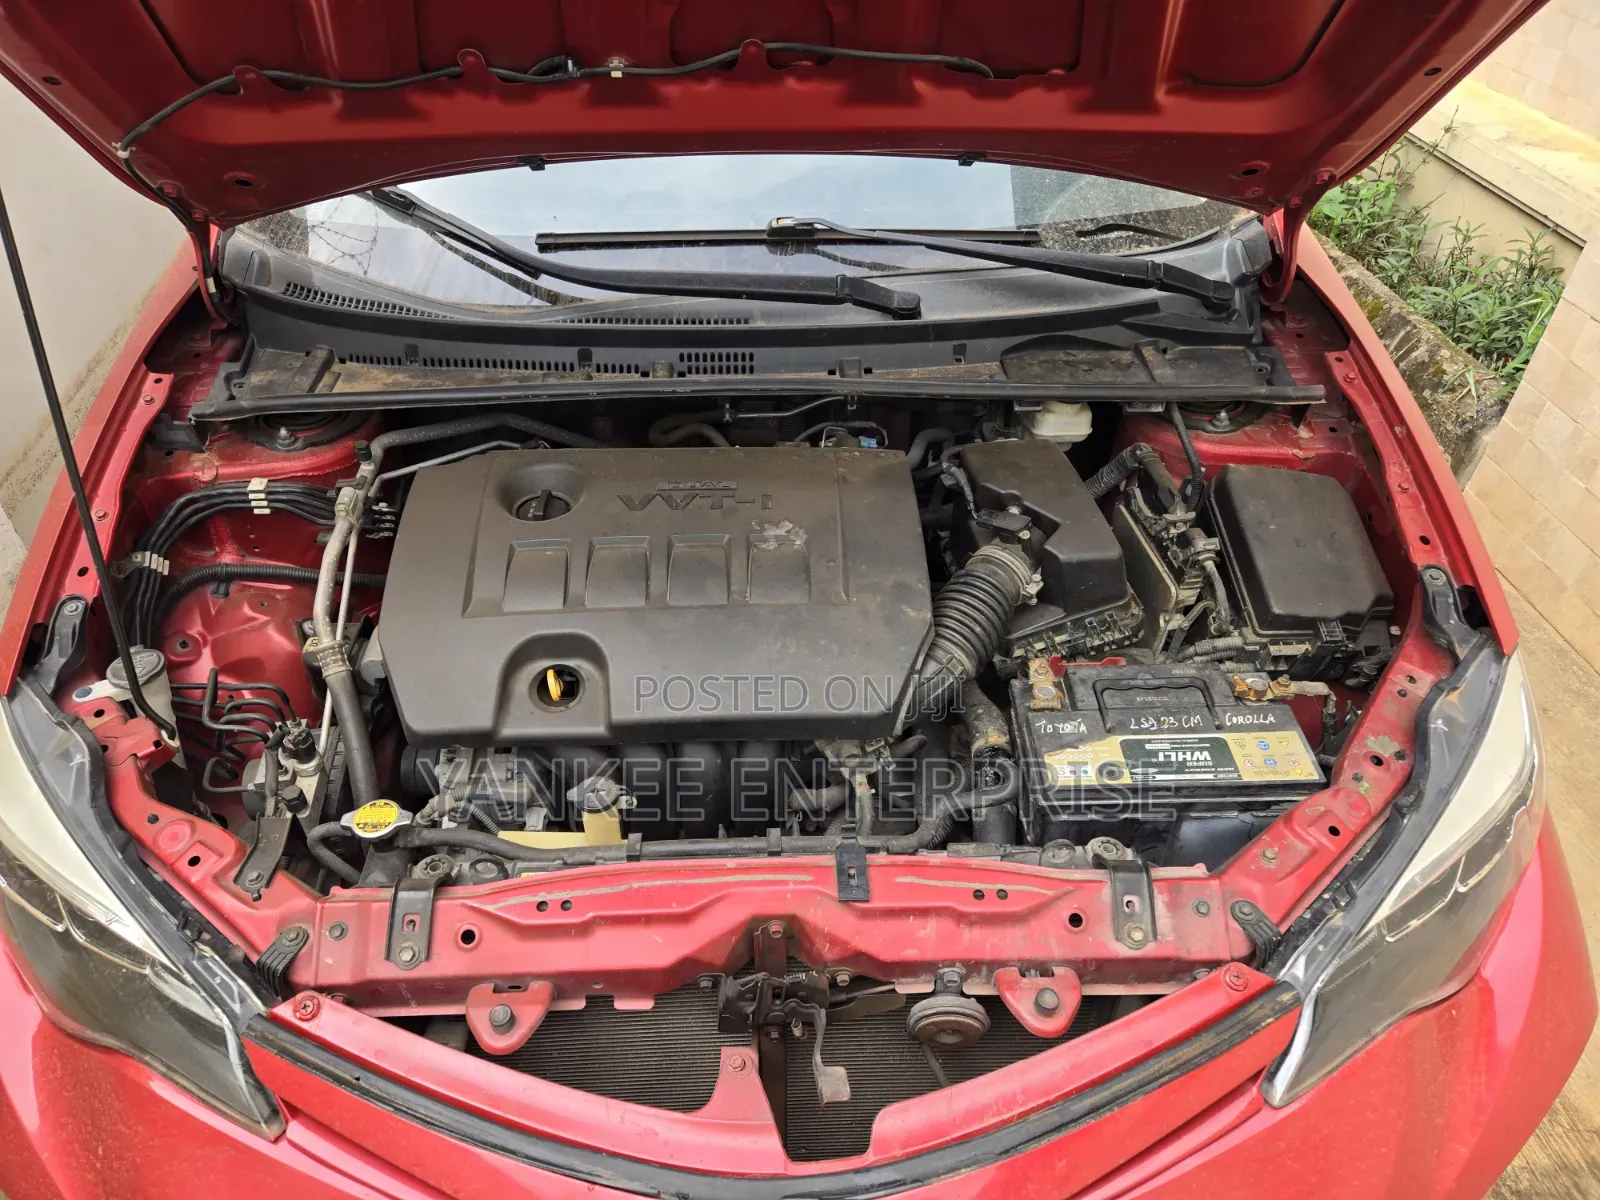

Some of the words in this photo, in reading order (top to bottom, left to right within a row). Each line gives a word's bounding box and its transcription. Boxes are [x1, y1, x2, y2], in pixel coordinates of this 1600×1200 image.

[667, 480, 733, 489] DUAL
[1182, 714, 1203, 728] CM
[1225, 712, 1276, 726] COROLLA
[1158, 750, 1212, 762] WHLI
